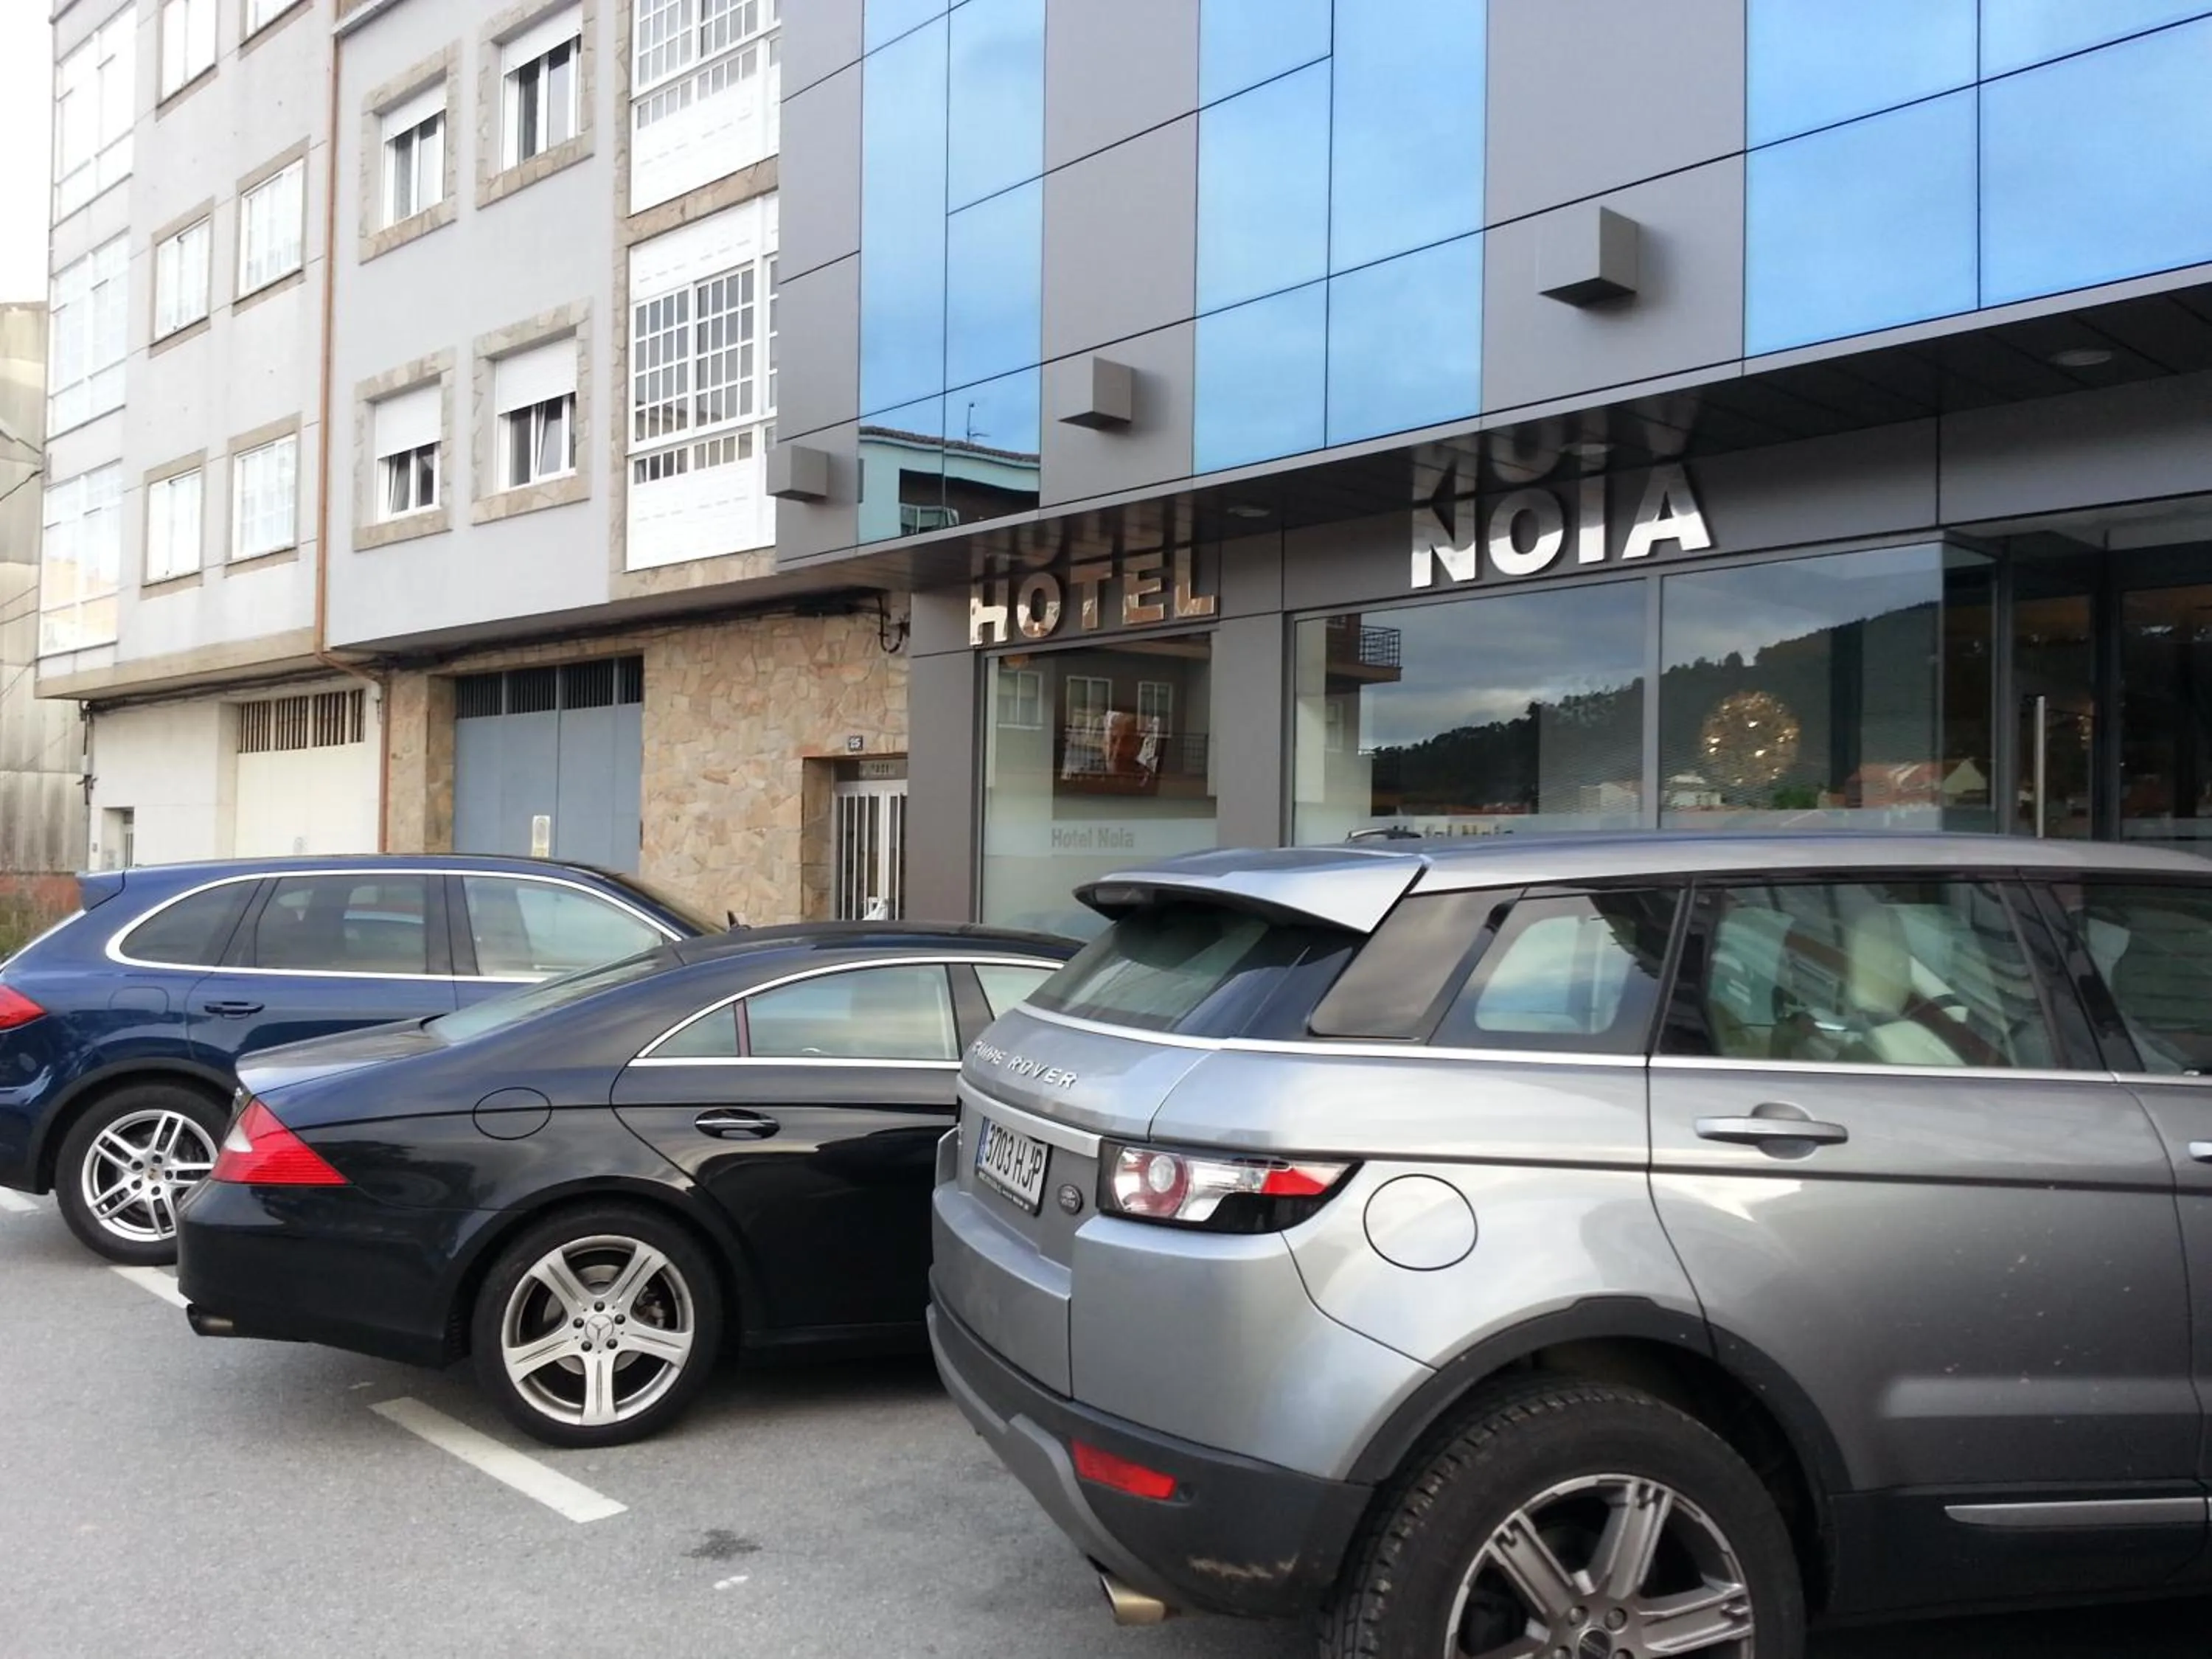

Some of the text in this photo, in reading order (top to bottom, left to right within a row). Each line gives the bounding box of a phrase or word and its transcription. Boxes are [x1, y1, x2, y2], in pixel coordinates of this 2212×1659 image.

[970, 462, 1711, 646] HOTEL NOIA
[1051, 827, 1134, 848] Hotel Noia
[1007, 1056, 1078, 1089] ROVER
[985, 1124, 1015, 1175] 3703
[1012, 1138, 1043, 1192] HJP
